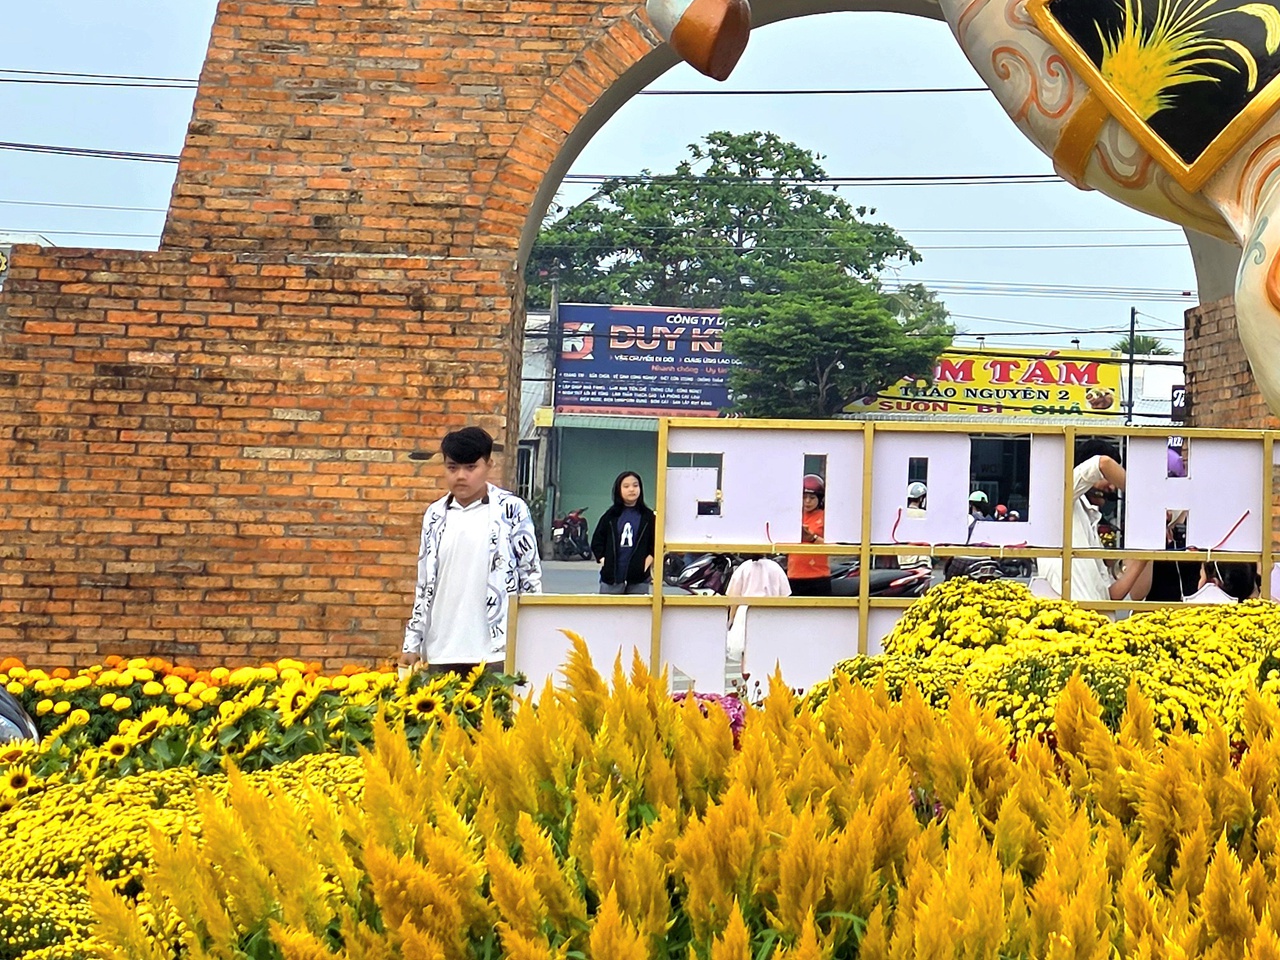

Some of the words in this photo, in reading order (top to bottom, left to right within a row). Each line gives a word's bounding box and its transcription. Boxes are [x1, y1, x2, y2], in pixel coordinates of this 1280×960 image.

[666, 313, 698, 325] CÔNG
[701, 316, 716, 326] TY
[610, 325, 686, 351] DUY
[965, 387, 1050, 401] NGUYÊN
[1058, 390, 1070, 401] 2
